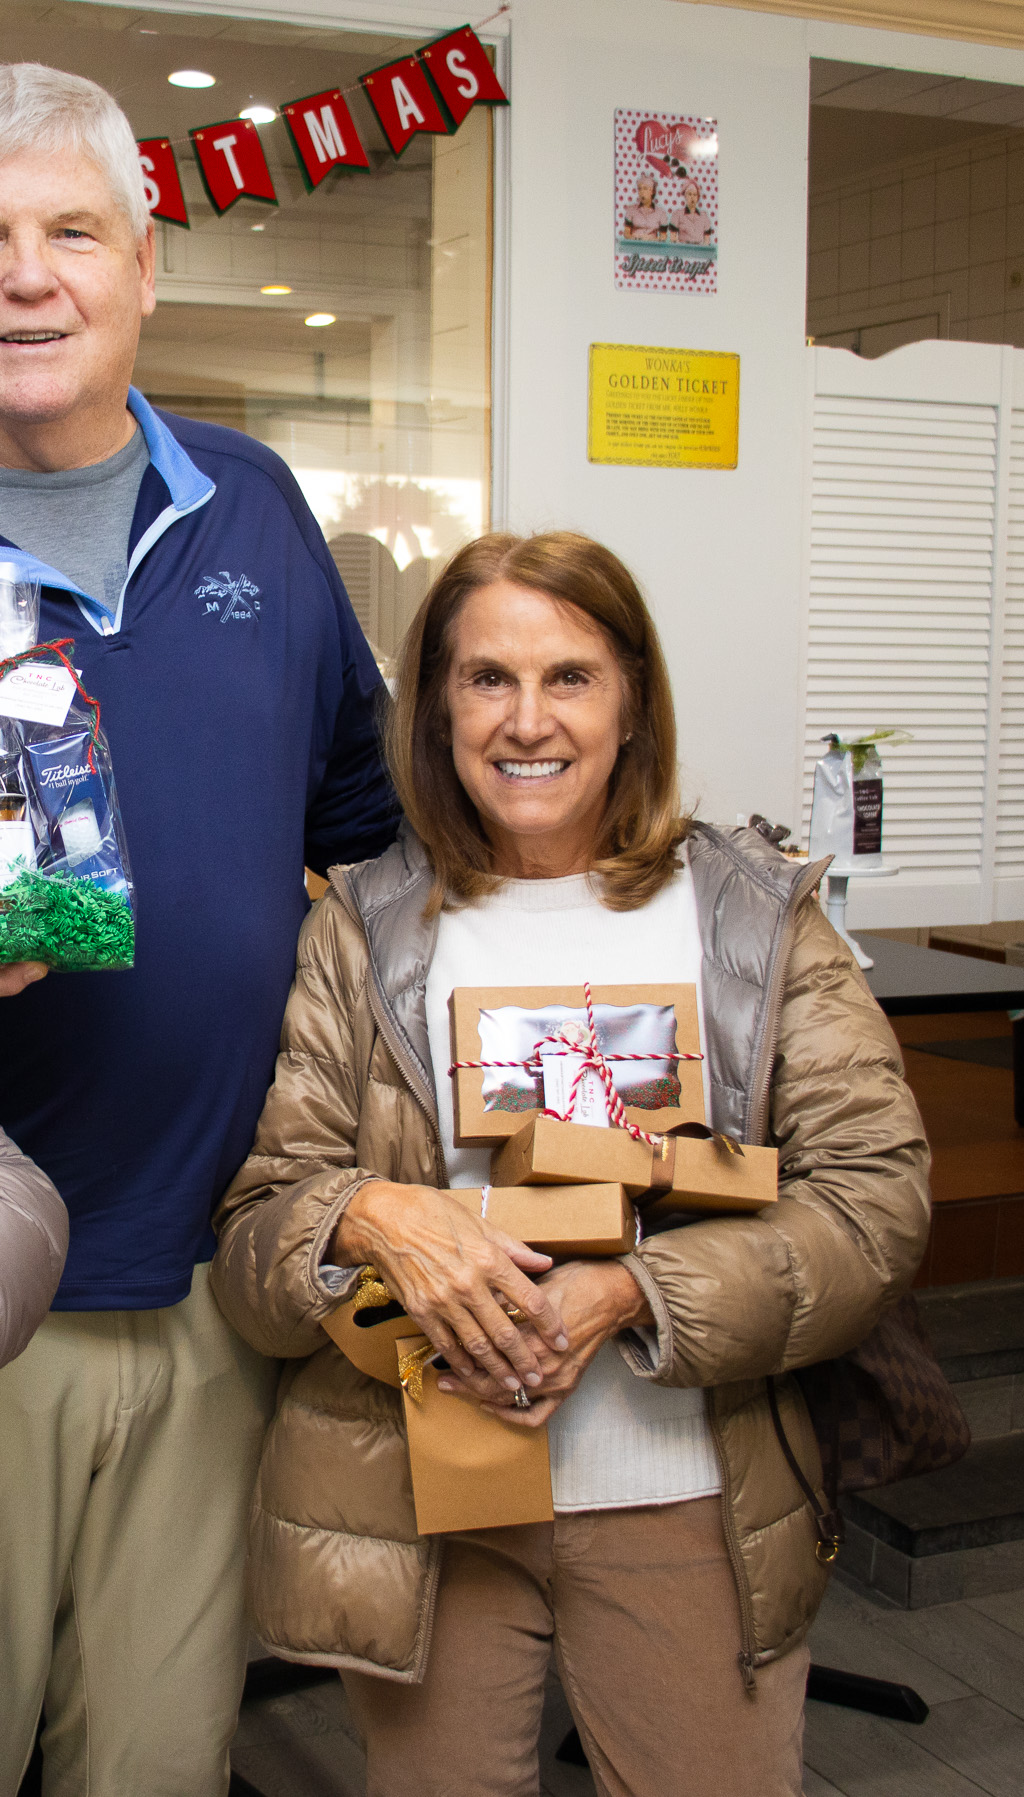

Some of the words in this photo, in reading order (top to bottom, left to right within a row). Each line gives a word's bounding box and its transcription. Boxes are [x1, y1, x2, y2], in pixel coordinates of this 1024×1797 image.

[622, 253, 668, 277] Speed
[645, 358, 691, 373] WONKA'S
[608, 374, 670, 391] GOLDEN
[676, 377, 728, 395] TICKET
[39, 763, 92, 786] Titleist
[55, 780, 67, 788] ball
